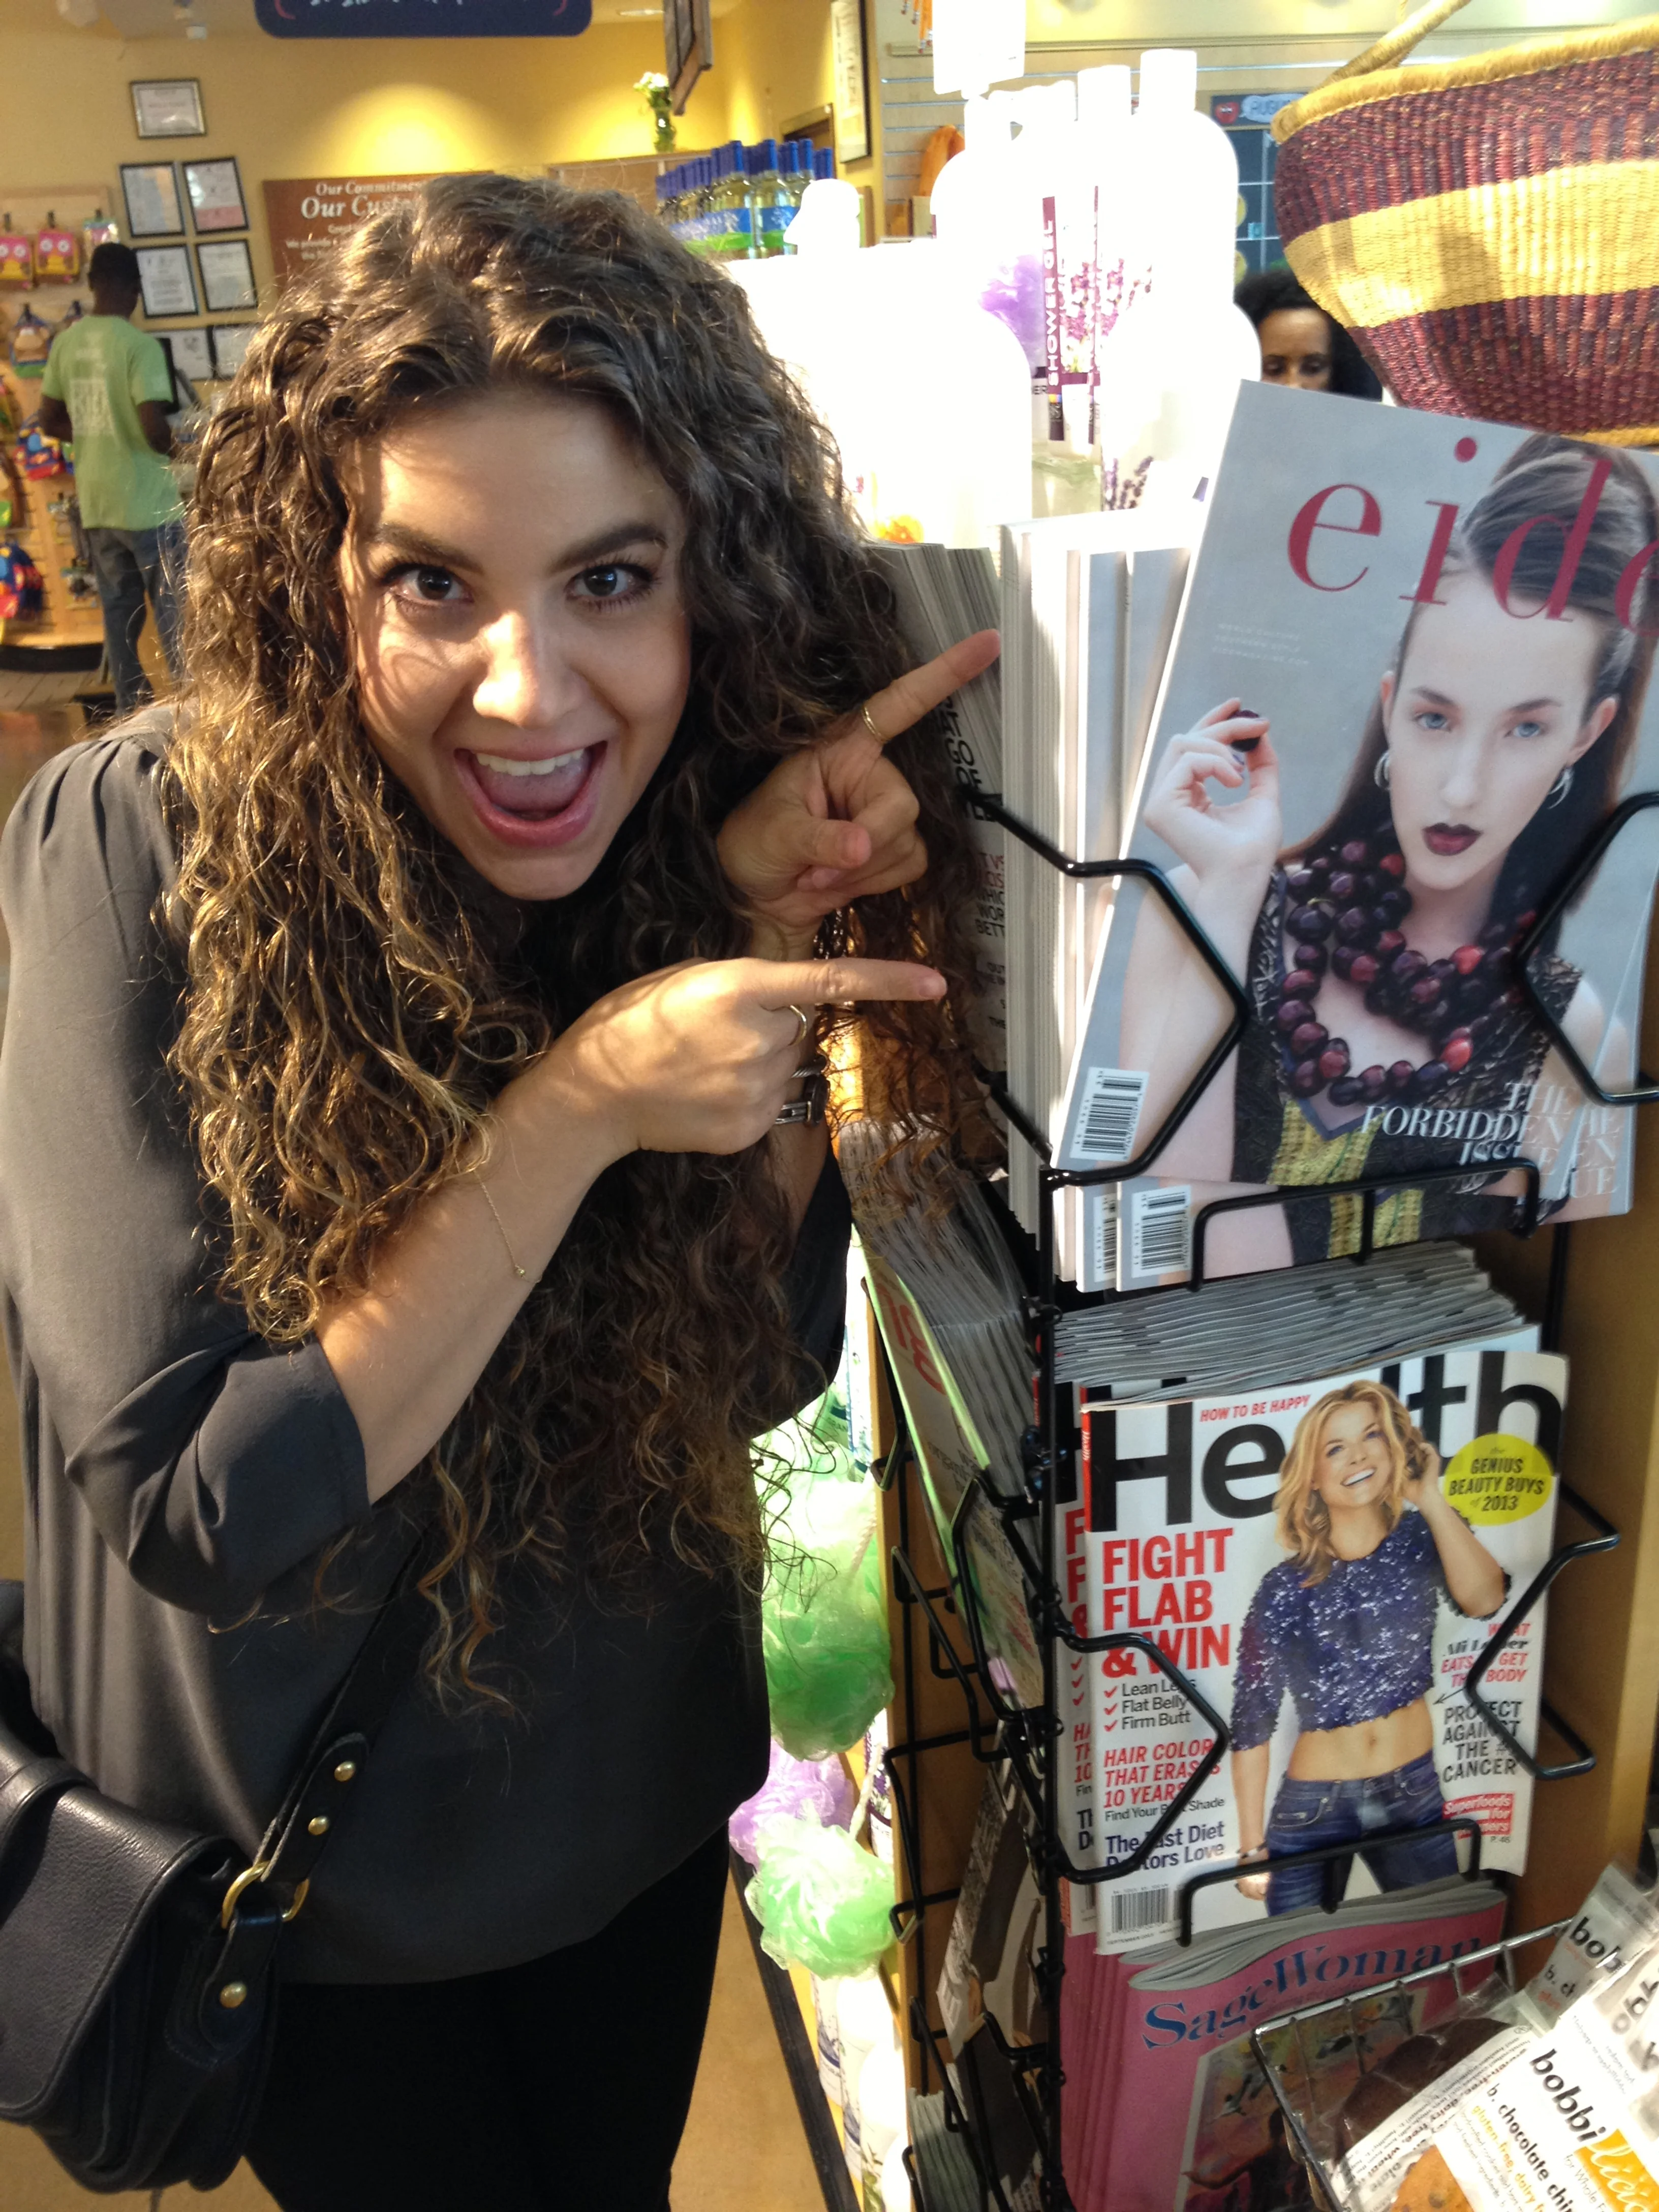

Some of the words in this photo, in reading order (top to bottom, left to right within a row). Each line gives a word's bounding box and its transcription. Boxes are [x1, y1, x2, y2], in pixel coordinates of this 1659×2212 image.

[316, 182, 343, 196] Our
[300, 195, 347, 220] Our
[1360, 1103, 1565, 1145] FORBIDDEN
[1200, 1406, 1230, 1423] HOW
[1233, 1404, 1248, 1418] TO
[1250, 1402, 1267, 1416] BE
[1269, 1395, 1311, 1413] HAPPY
[1470, 1458, 1524, 1474] GENIUS
[1449, 1476, 1504, 1496] BEAUTY
[1504, 1477, 1545, 1495] BUYS
[1482, 1495, 1519, 1512] 2013
[1102, 1527, 1234, 1585] FIGHT
[1102, 1580, 1214, 1631] FLAB
[1142, 1623, 1231, 1674] WIN
[1498, 1653, 1528, 1666] GET
[1121, 1682, 1159, 1697] Lean
[1161, 1678, 1196, 1693] Les
[1486, 1669, 1528, 1683] BODY
[1122, 1698, 1149, 1714] Flat
[1152, 1694, 1188, 1710] Belly
[1443, 1701, 1523, 1725] PROECT
[1122, 1715, 1156, 1730] Firm
[1158, 1710, 1191, 1727] Butt
[1103, 1745, 1147, 1768] HAIR
[1455, 1739, 1489, 1761] THE
[1104, 1765, 1150, 1788] THAT
[1442, 1758, 1517, 1783] CANCER
[1103, 1789, 1125, 1809] 10
[1105, 1809, 1130, 1822] Find
[1132, 1806, 1158, 1818] Your
[1188, 1797, 1225, 1811] Shade
[1105, 1835, 1140, 1854] The
[1188, 1821, 1225, 1844] Diet
[1184, 1843, 1224, 1864] Love
[1529, 2048, 1607, 2143] bobbi
[1487, 2083, 1500, 2102] b.
[1498, 2104, 1550, 2182] chocolate
[1514, 2172, 1536, 2204] dairy
